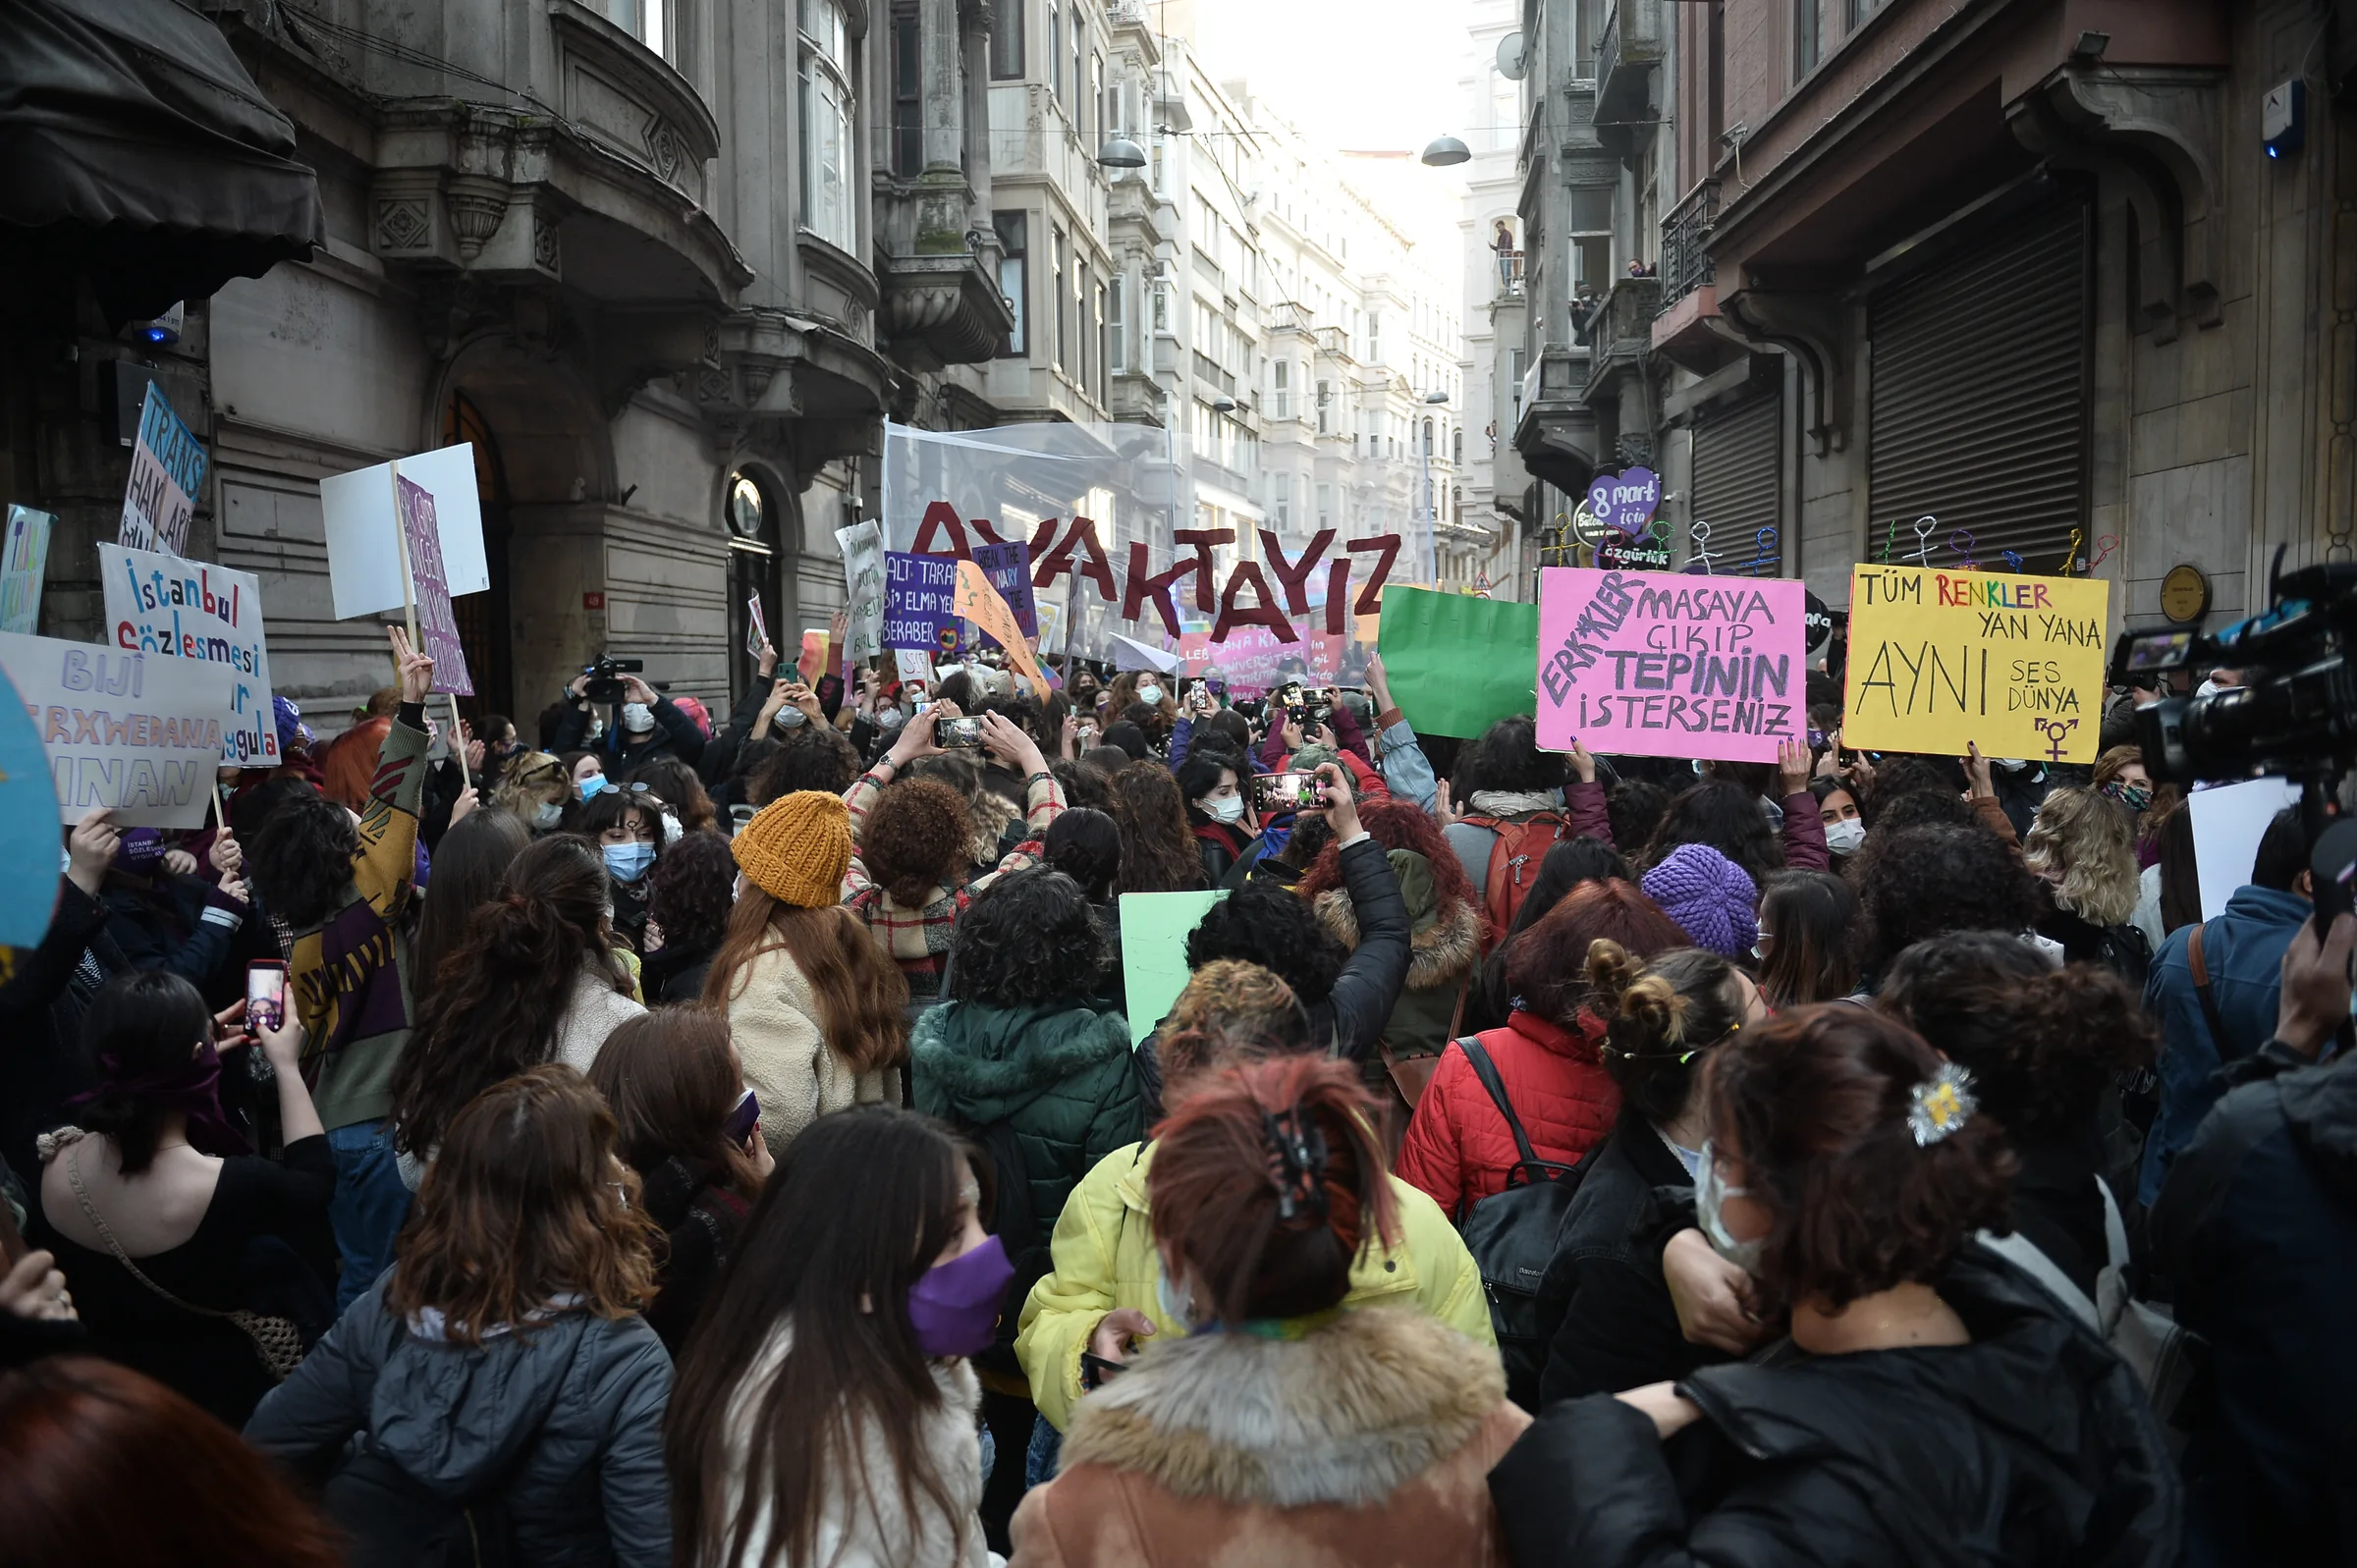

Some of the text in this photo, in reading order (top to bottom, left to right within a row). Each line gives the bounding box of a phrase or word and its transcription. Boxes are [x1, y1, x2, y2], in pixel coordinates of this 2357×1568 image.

[146, 392, 203, 499] TRANS
[130, 452, 191, 557] HAKARI
[1593, 487, 1611, 517] 8
[1619, 508, 1645, 525] için
[886, 556, 912, 581] ALT
[977, 545, 1020, 568] BREAK THE
[1605, 544, 1668, 565] özgürlük
[905, 591, 937, 611] ELMA
[1009, 590, 1023, 609] THE
[1860, 568, 2053, 609] TÜM RENKLER
[1637, 588, 1775, 623] MASAYA
[883, 620, 937, 644] BERABER
[1646, 624, 1753, 654] ÇIKIP
[1978, 611, 2102, 649] YAN YANA
[1212, 635, 1252, 656] SANA
[1605, 646, 1789, 700] TEPİNİN
[1856, 640, 1987, 718] AYNI
[2010, 659, 2061, 683] SES
[2008, 684, 2079, 714] DÜNYA
[27, 704, 221, 750] RXWEDANA
[1579, 693, 1794, 736] İSTERSENİZ
[221, 710, 276, 762] ygula
[55, 756, 197, 807] INAN
